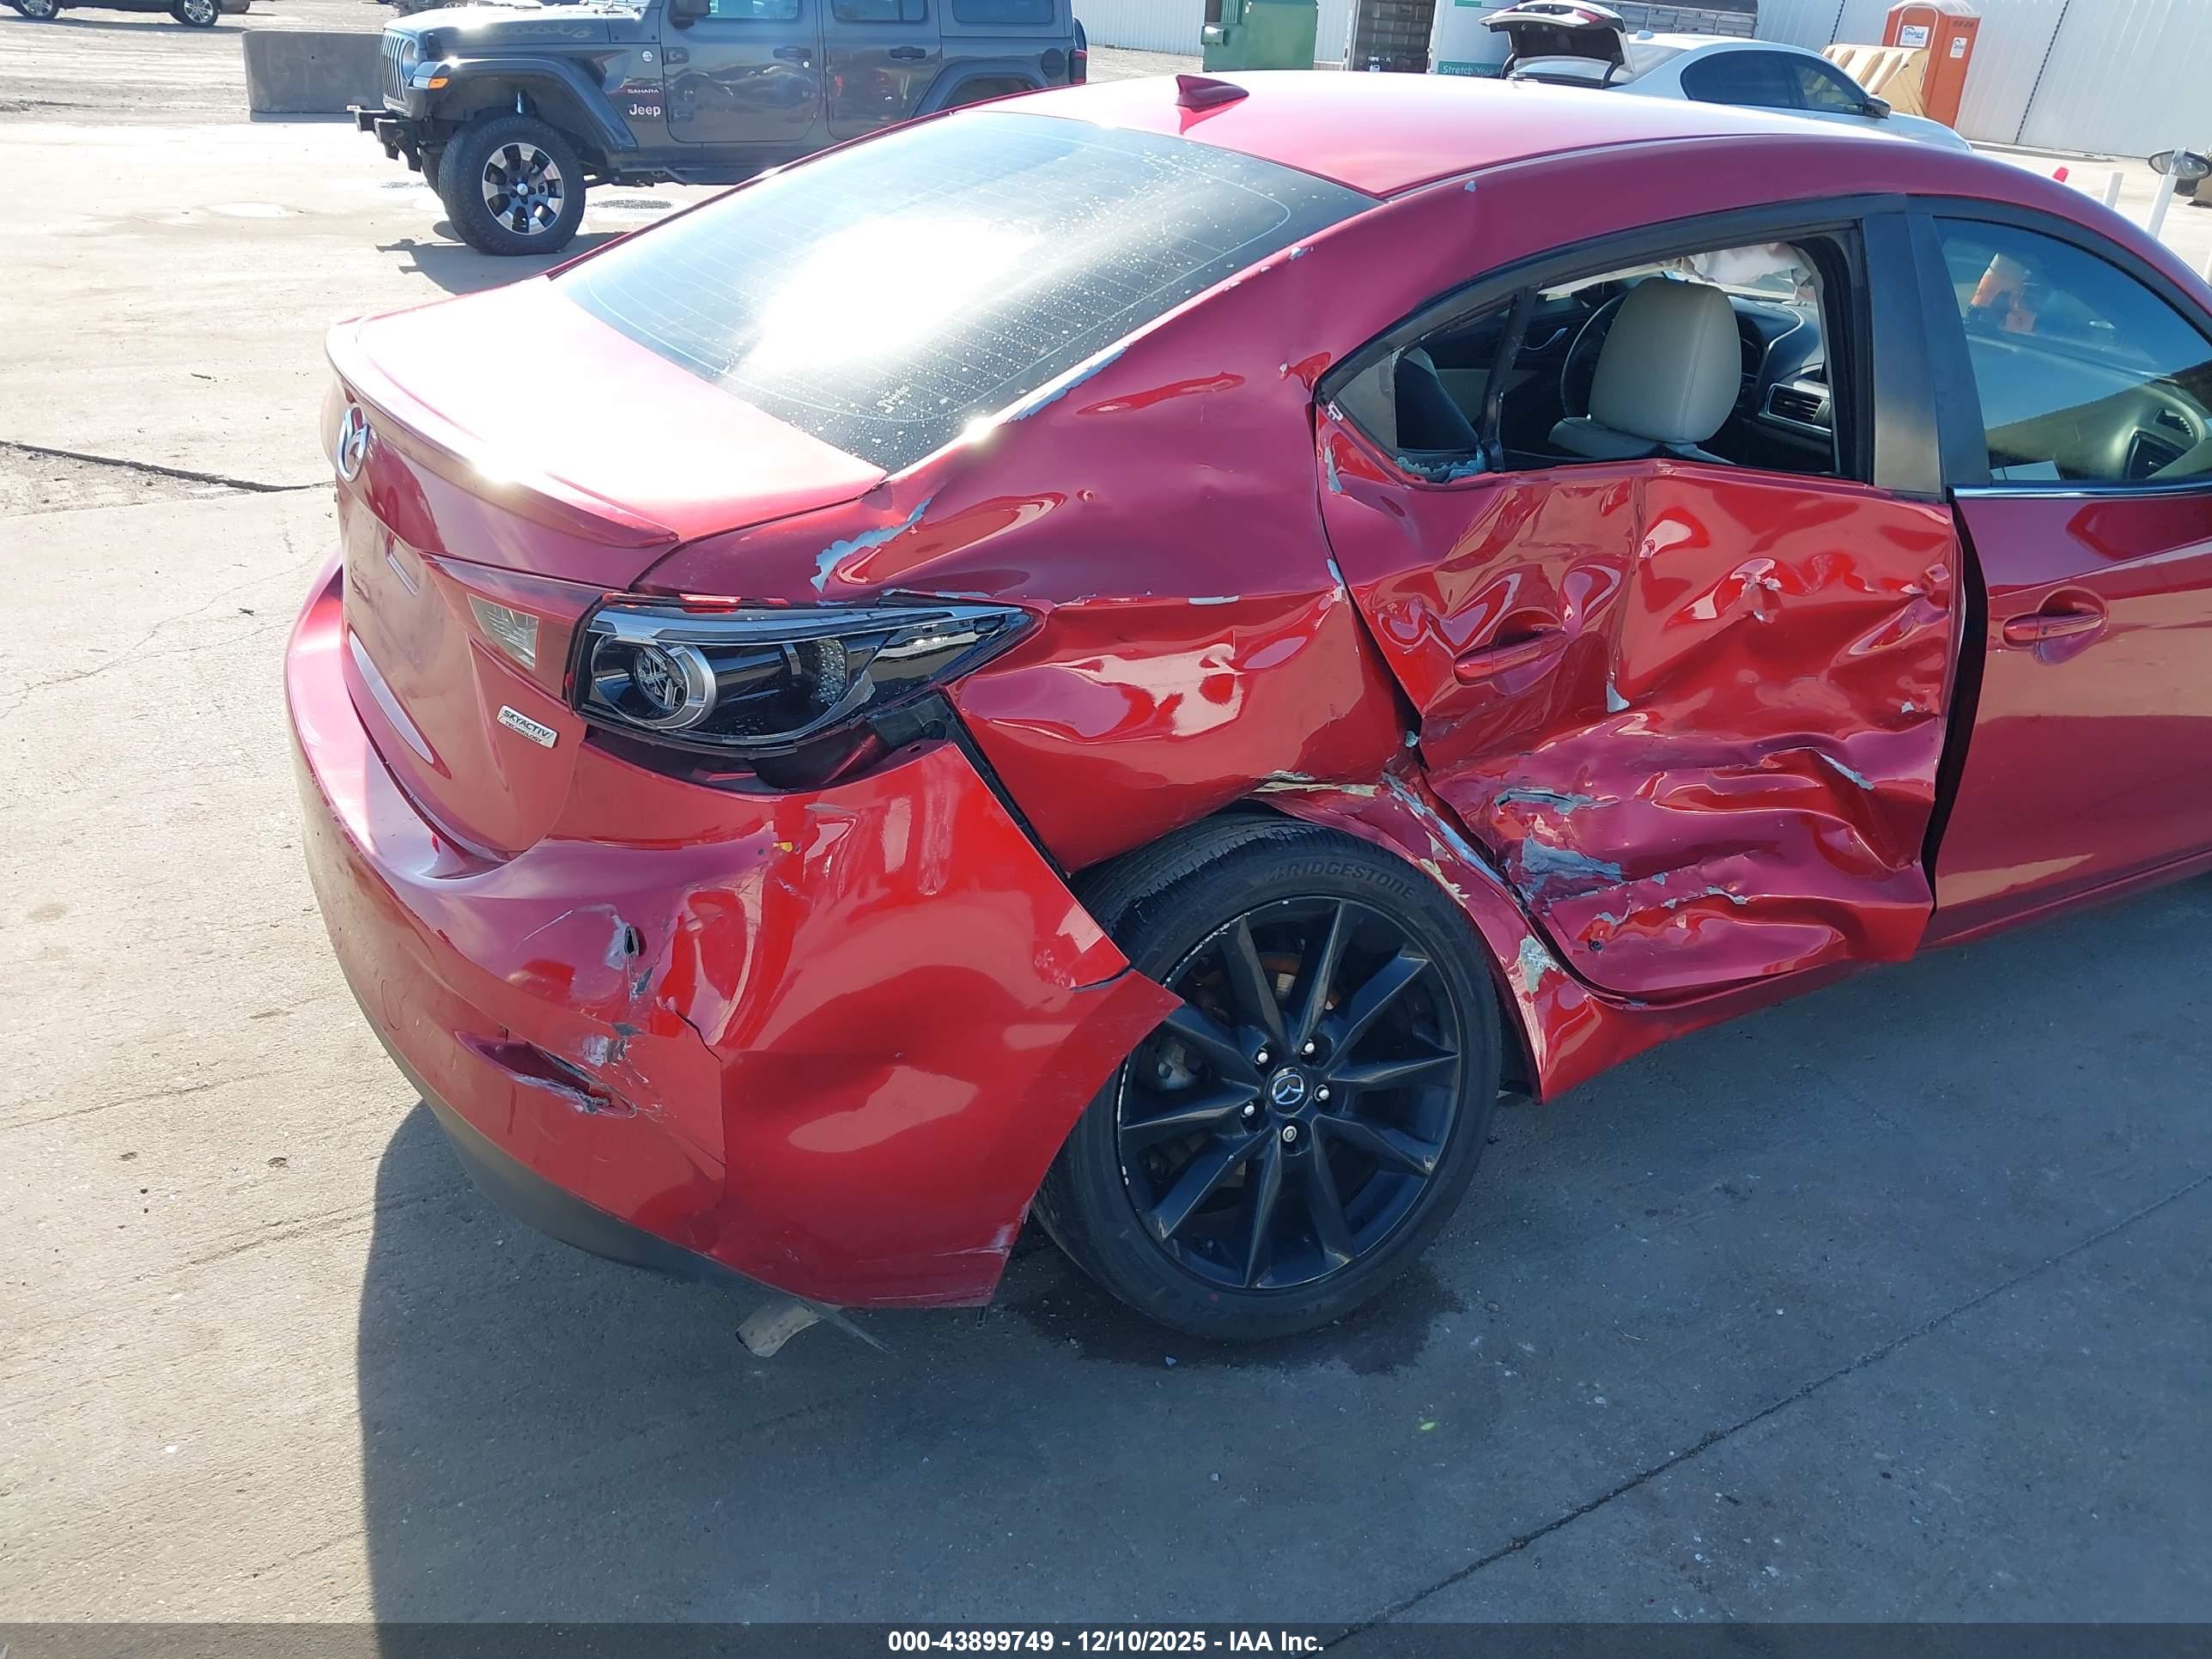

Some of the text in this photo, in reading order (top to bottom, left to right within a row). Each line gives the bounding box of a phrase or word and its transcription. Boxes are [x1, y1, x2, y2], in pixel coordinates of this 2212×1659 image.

[1443, 64, 1474, 76] Stretch
[629, 103, 661, 117] Jeep
[503, 709, 550, 737] SKYACTIV
[505, 720, 543, 743] TECHNOLOGY
[1267, 860, 1416, 900] BRIDGESTONE
